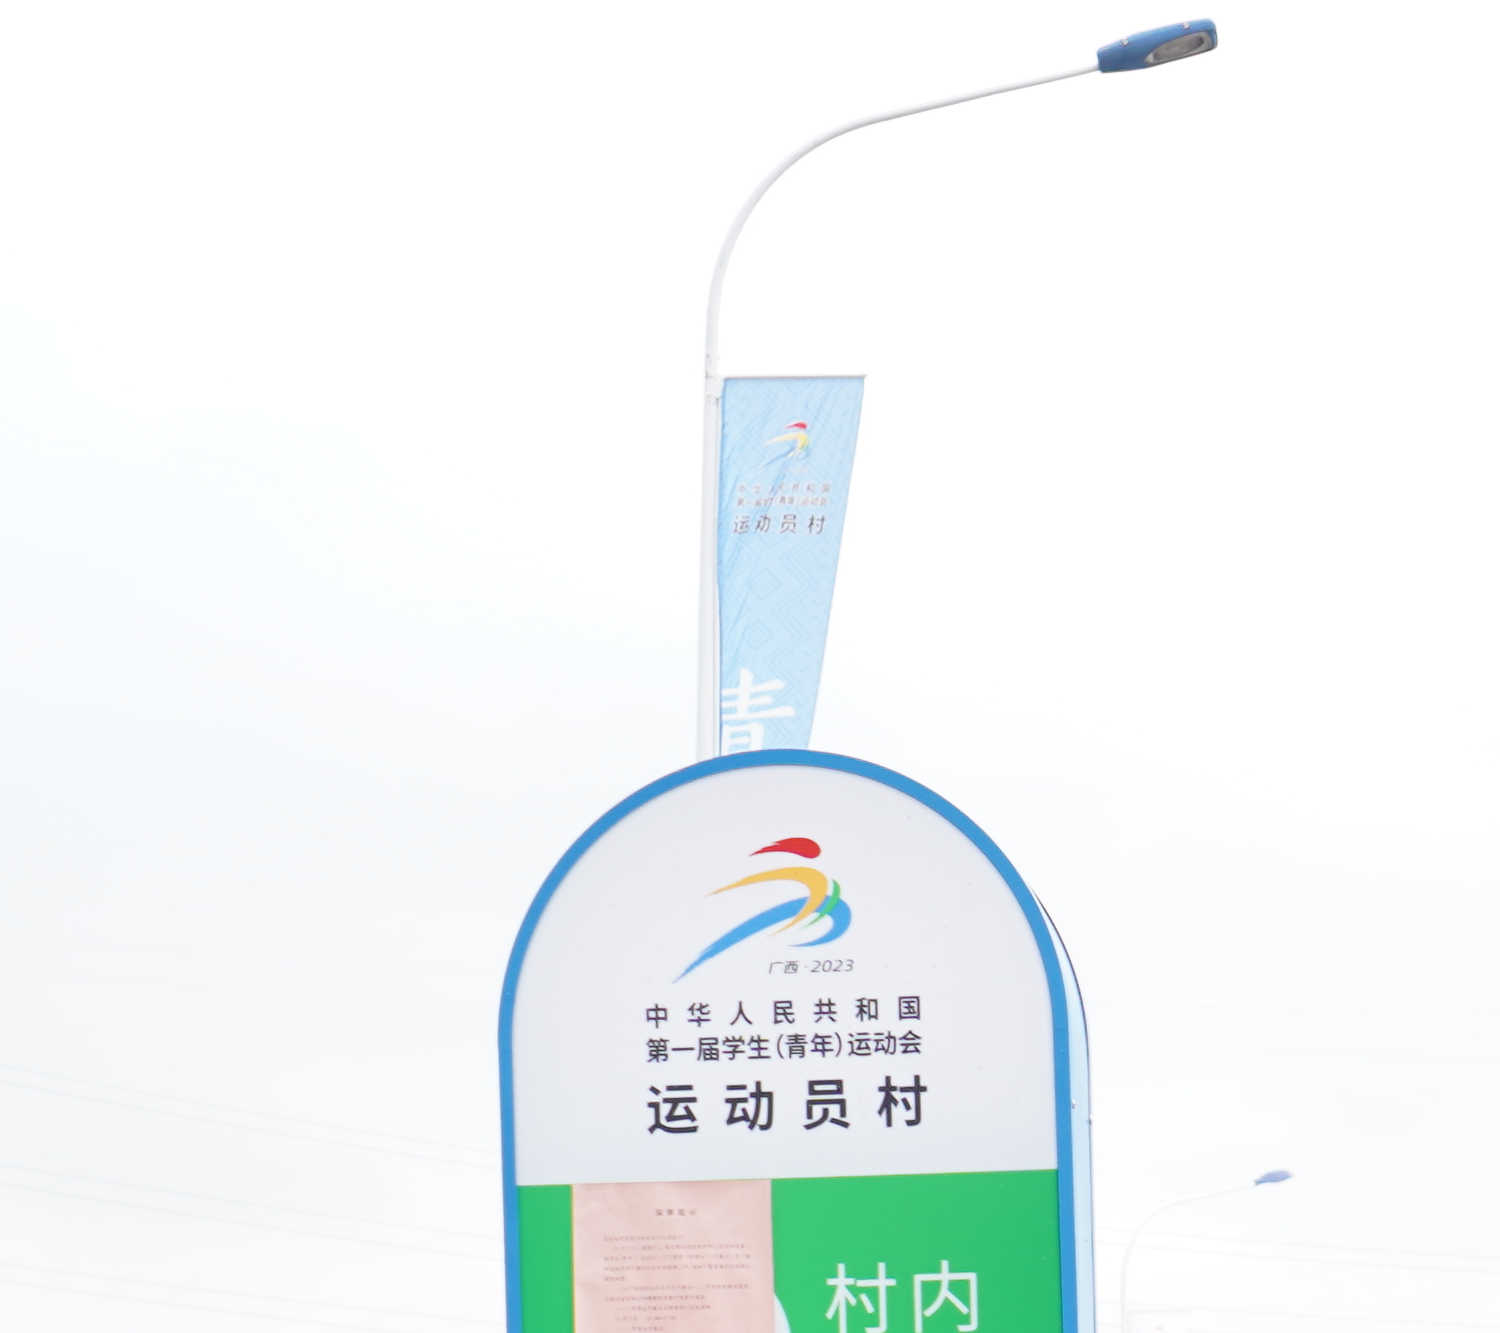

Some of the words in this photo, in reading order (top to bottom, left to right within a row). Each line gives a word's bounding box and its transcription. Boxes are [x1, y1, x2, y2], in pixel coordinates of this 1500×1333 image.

[733, 513, 826, 535] 运动员村
[645, 994, 922, 1030] 中华人民共和国
[646, 1029, 923, 1063] 第一届学生(青年)运动会
[646, 1074, 928, 1135] 运动员村
